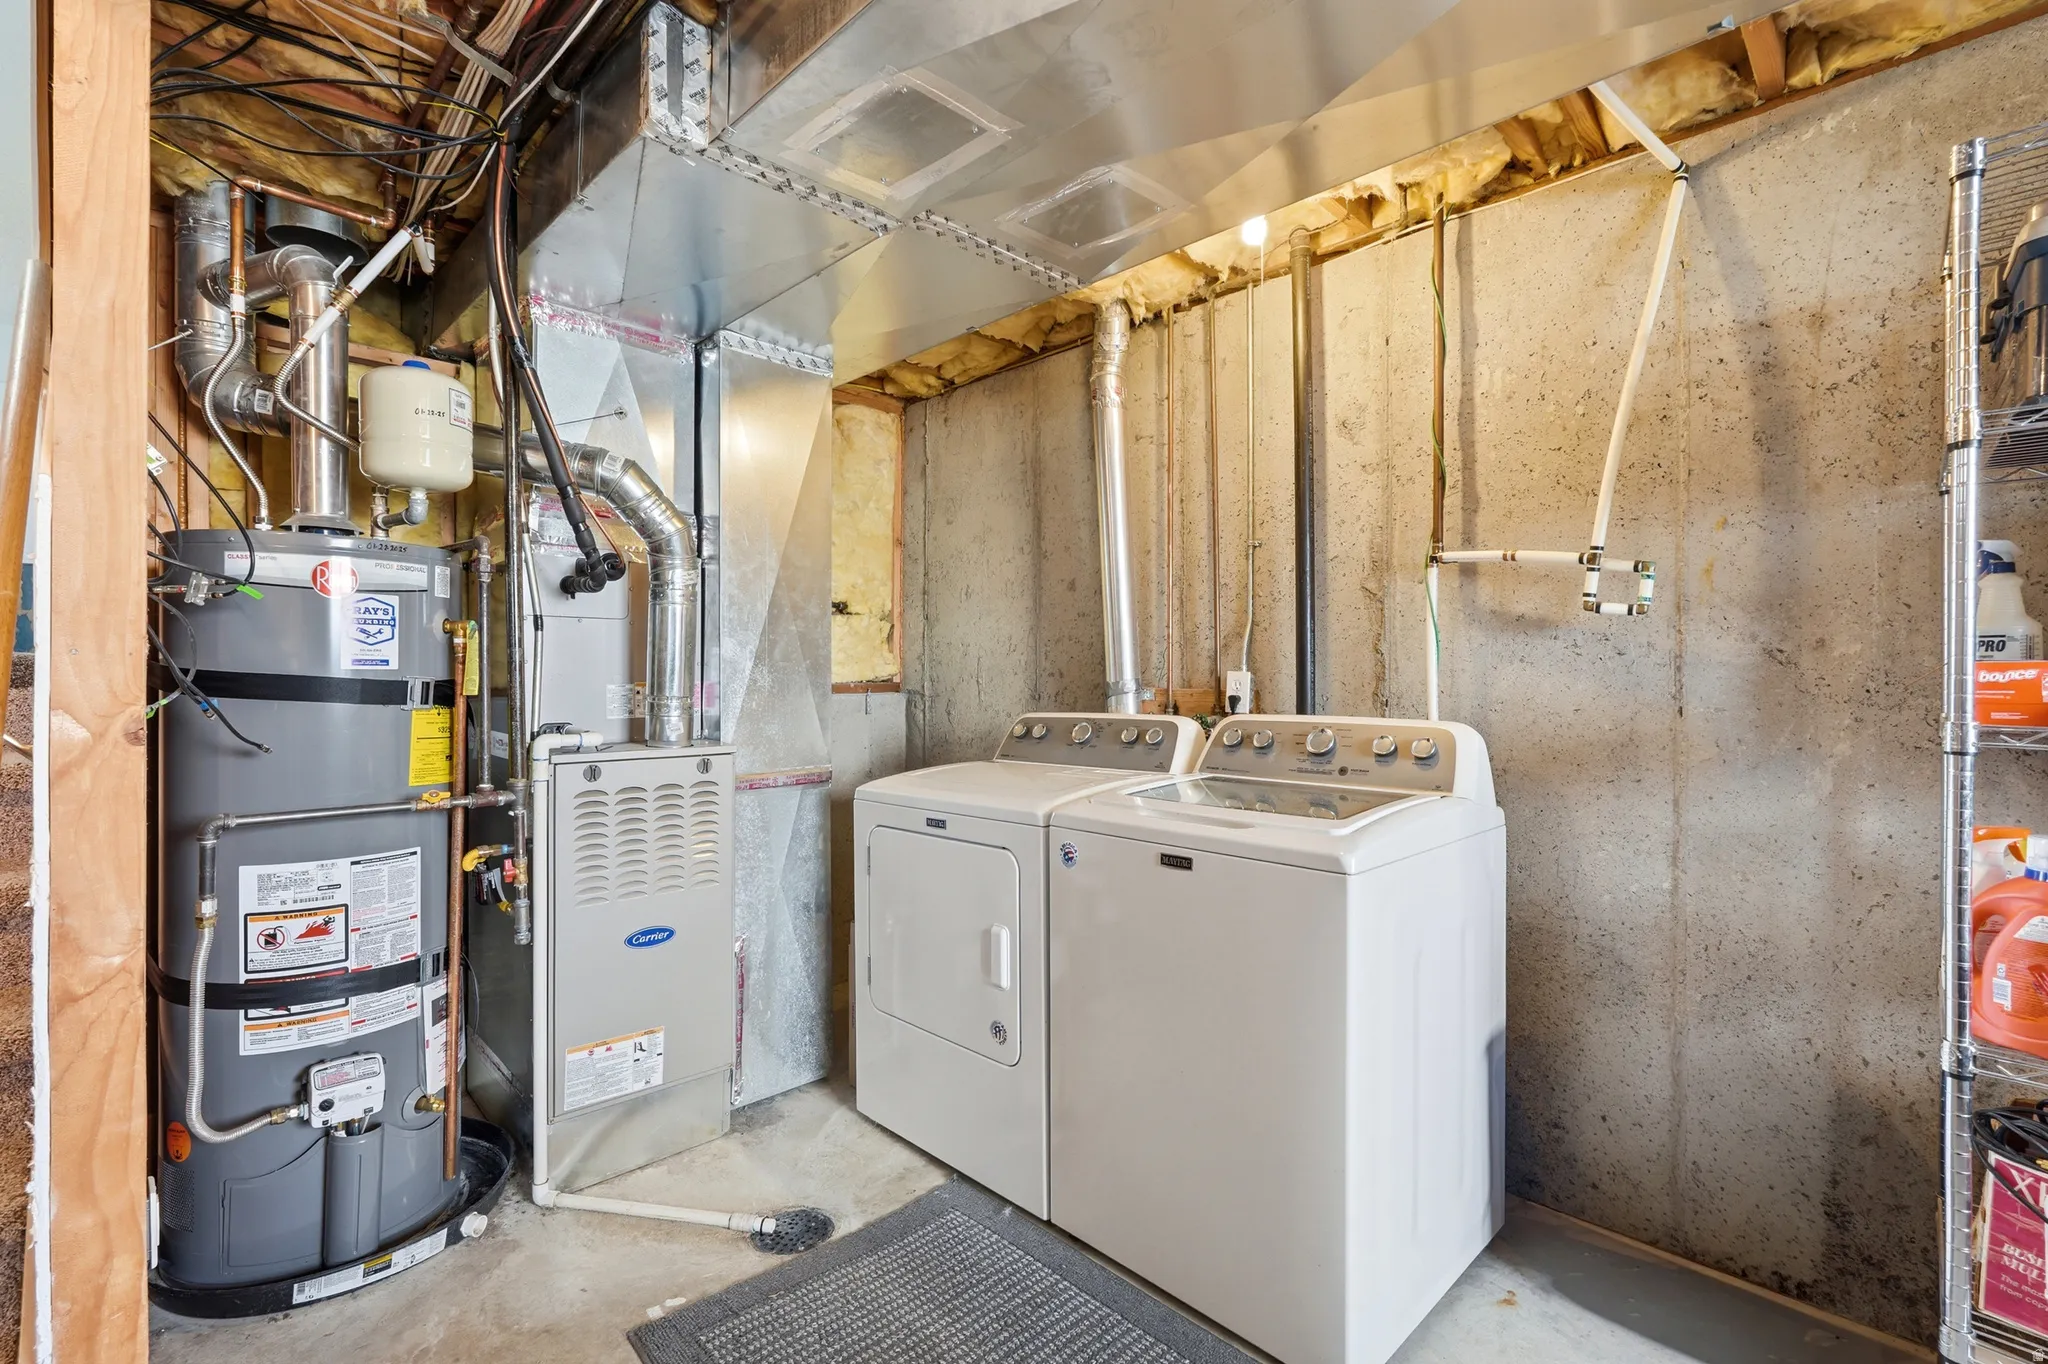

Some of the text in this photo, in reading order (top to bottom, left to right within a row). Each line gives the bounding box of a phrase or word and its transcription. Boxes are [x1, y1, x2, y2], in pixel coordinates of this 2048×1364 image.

[352, 606, 390, 616] RAY'S
[351, 618, 396, 627] UMBING
[1978, 669, 2039, 683] bounce
[1161, 856, 1191, 867] MAYTAG
[632, 930, 670, 944] Carrier
[286, 1017, 317, 1027] WARNING
[2000, 1255, 2046, 1283] MUL
